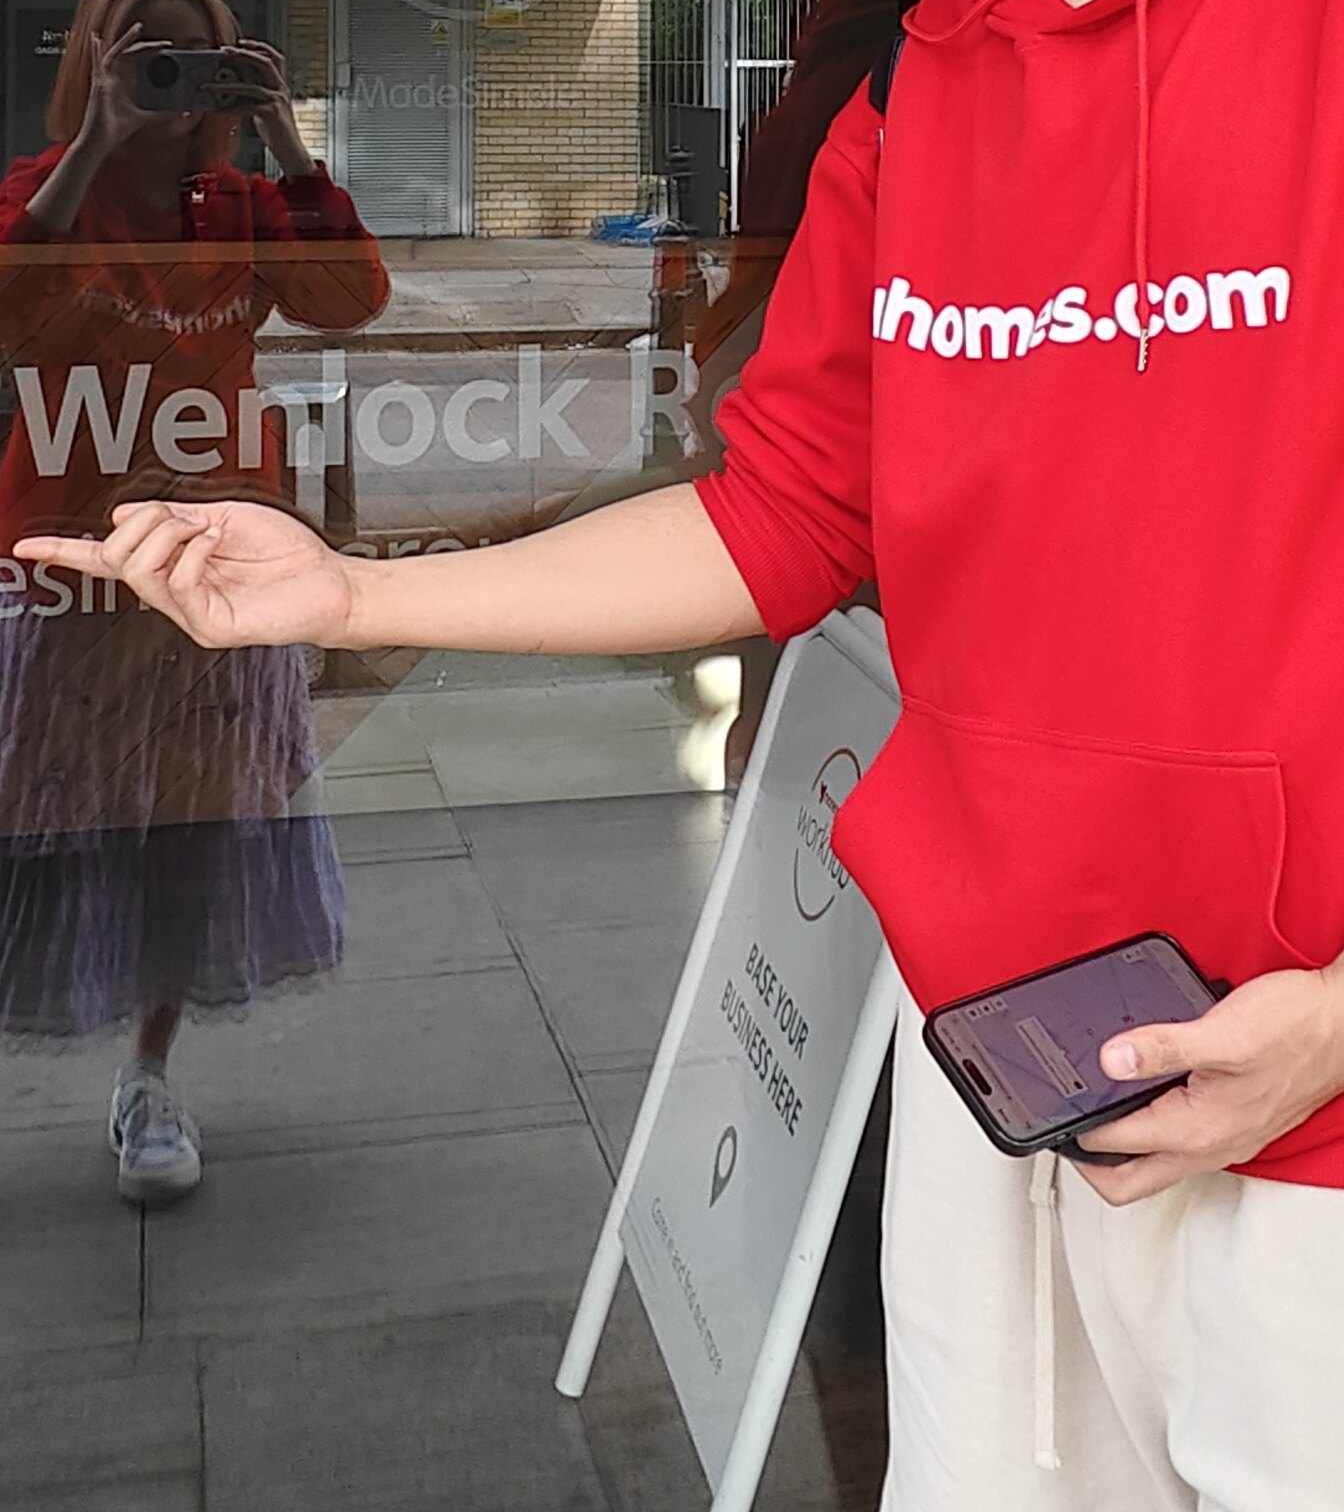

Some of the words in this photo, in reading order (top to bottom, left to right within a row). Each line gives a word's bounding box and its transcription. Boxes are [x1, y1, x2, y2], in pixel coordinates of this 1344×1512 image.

[872, 265, 1290, 360] homes.com
[13, 343, 592, 477] Wenlock
[721, 978, 773, 1082] BUSINESS
[767, 1060, 803, 1137] HERE
[745, 942, 778, 1007] BASE
[773, 984, 809, 1060] YOUR
